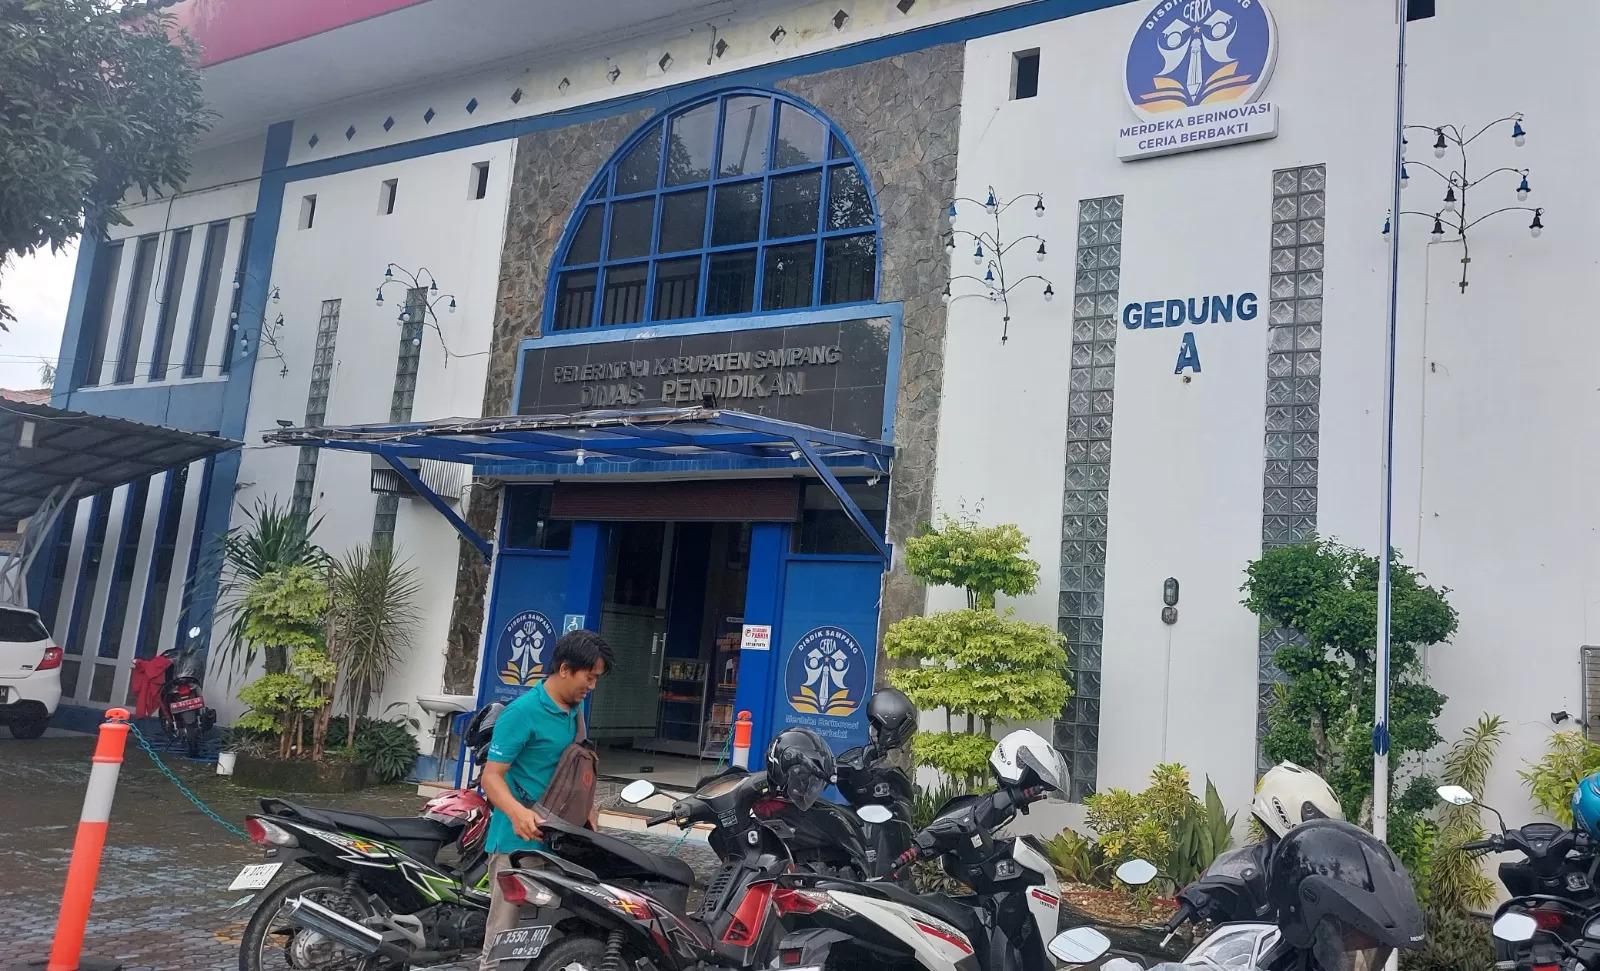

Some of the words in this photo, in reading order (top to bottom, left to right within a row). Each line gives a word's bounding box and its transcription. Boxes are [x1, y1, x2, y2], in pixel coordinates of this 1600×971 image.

[1119, 118, 1184, 138] MERDEKA
[1187, 102, 1271, 126] BERINOVASI
[1138, 135, 1177, 150] CERIA
[1180, 122, 1248, 143] BERBAKTI
[1122, 292, 1258, 330] GEDUNG
[652, 352, 751, 375] KABUPATEN
[753, 344, 842, 369] SAMPANG
[1174, 332, 1201, 375] A
[579, 382, 645, 407] DINAS
[661, 371, 806, 402] PENDIDIKAN
[798, 630, 823, 651] DISDIK
[825, 629, 858, 654] SAMPANG
